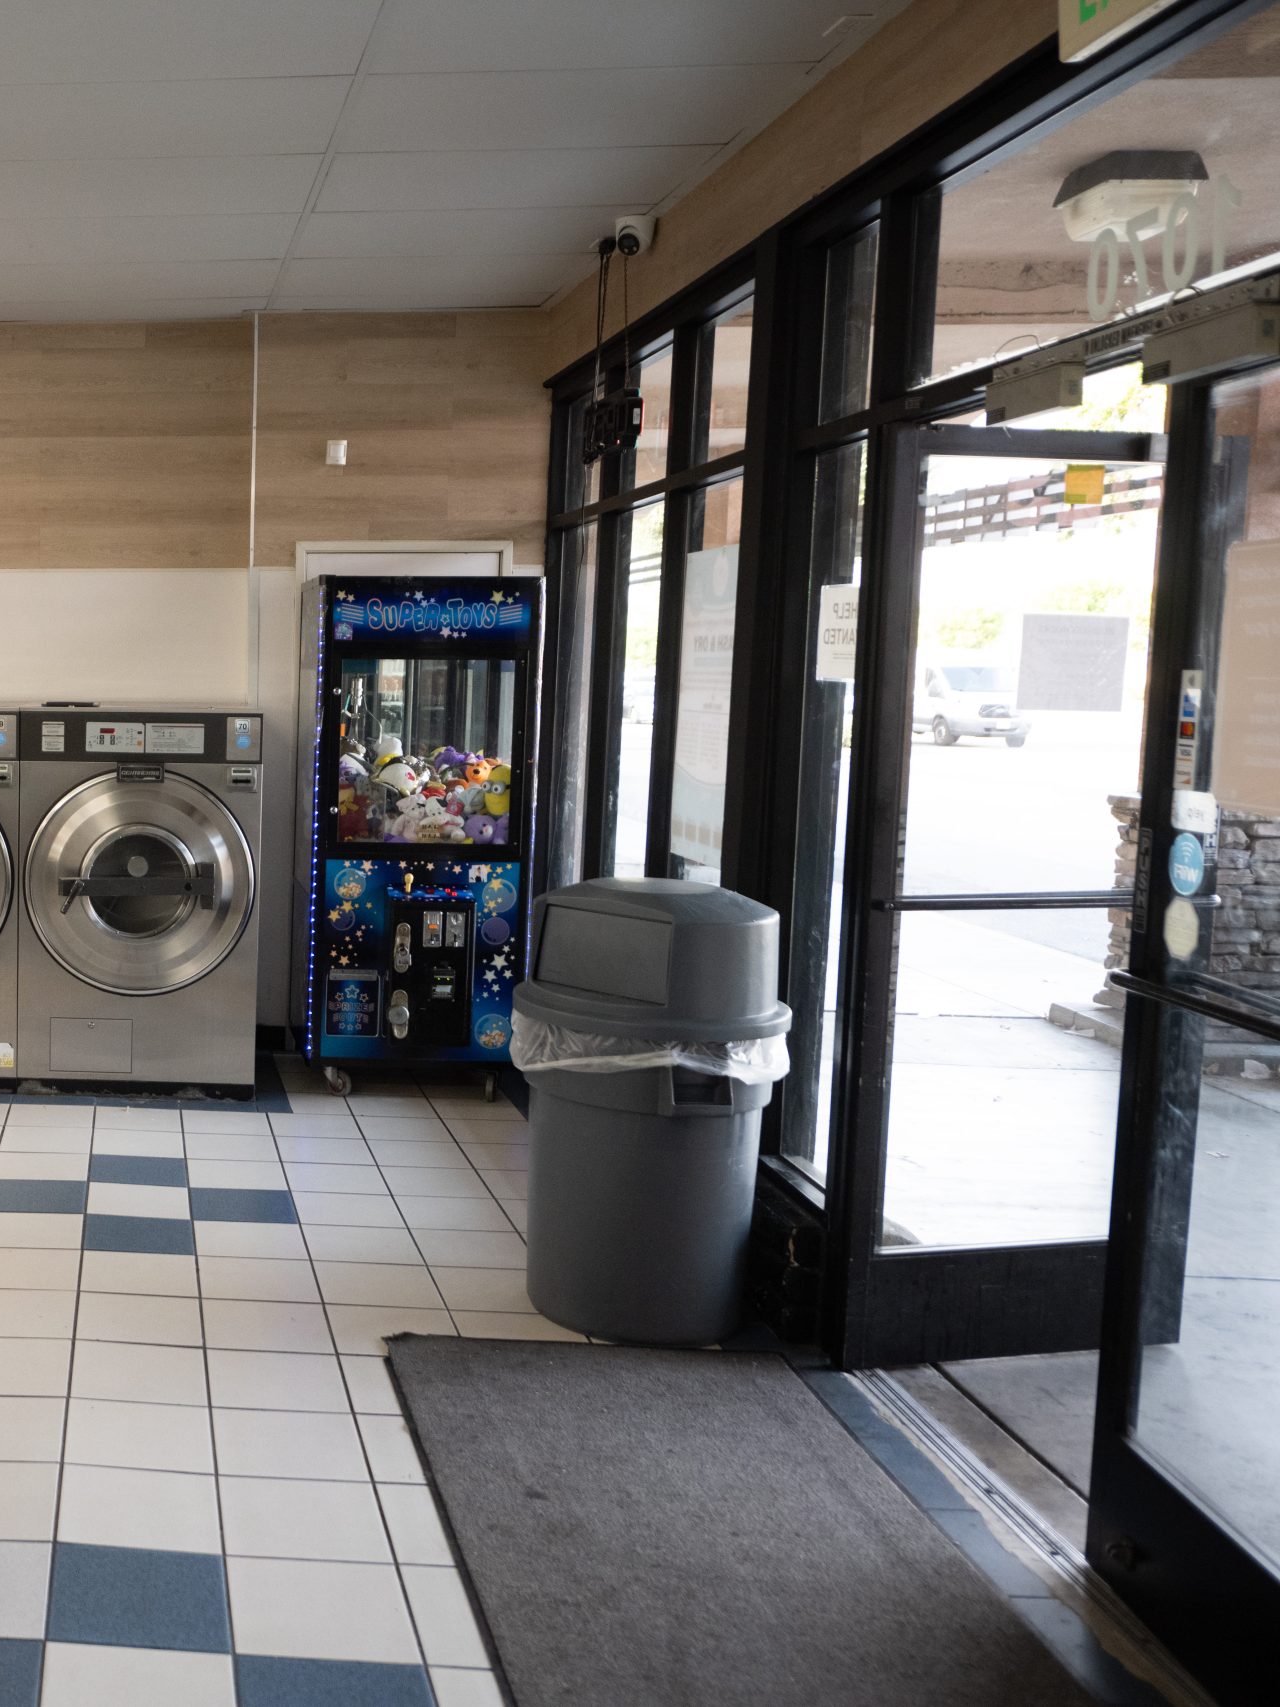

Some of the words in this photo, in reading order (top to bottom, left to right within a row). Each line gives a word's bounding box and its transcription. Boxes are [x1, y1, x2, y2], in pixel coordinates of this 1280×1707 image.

[366, 597, 441, 633] SUPER
[446, 597, 498, 630] TOYS
[237, 723, 248, 731] 70
